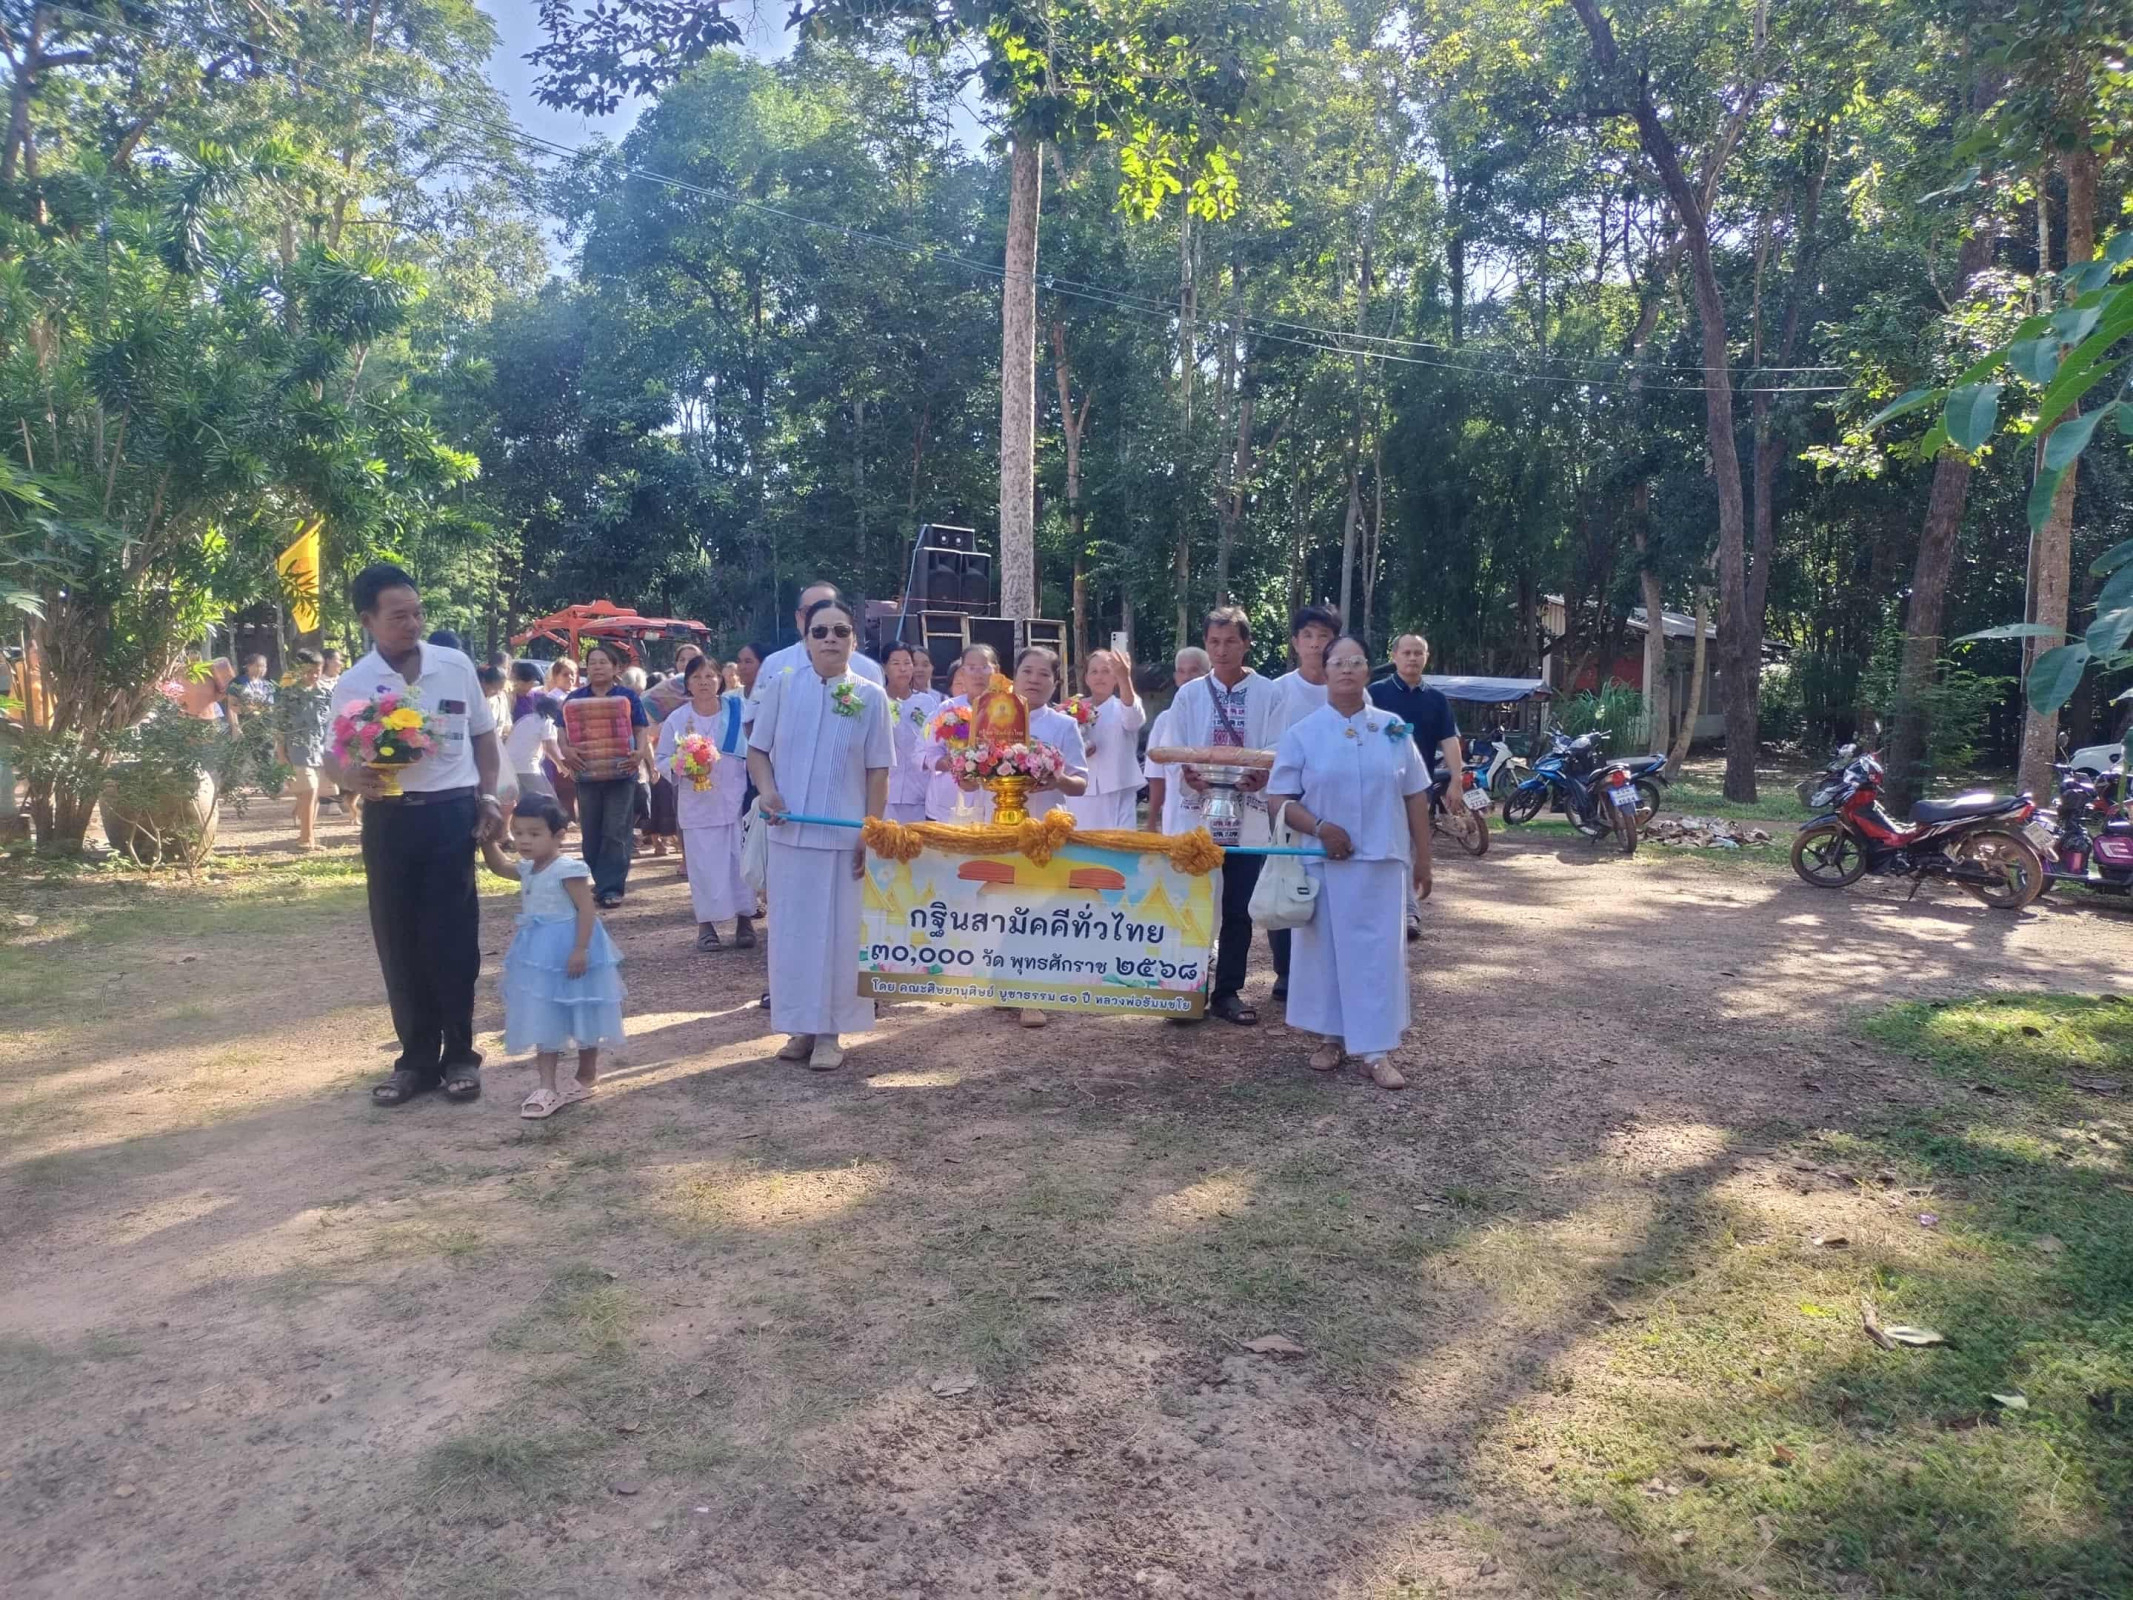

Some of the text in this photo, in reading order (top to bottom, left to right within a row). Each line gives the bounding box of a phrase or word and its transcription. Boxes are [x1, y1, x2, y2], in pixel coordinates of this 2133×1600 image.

[910, 901, 1165, 944] กฐินสามัคคีทั่วไทย
[871, 944, 1199, 981] ๓๐,๐๐๐ วัด พุทธศักราช ๒๕๖๘
[871, 977, 896, 993] โดย
[999, 988, 1057, 1003] บูชาธรรม
[1081, 990, 1092, 1005] ปี
